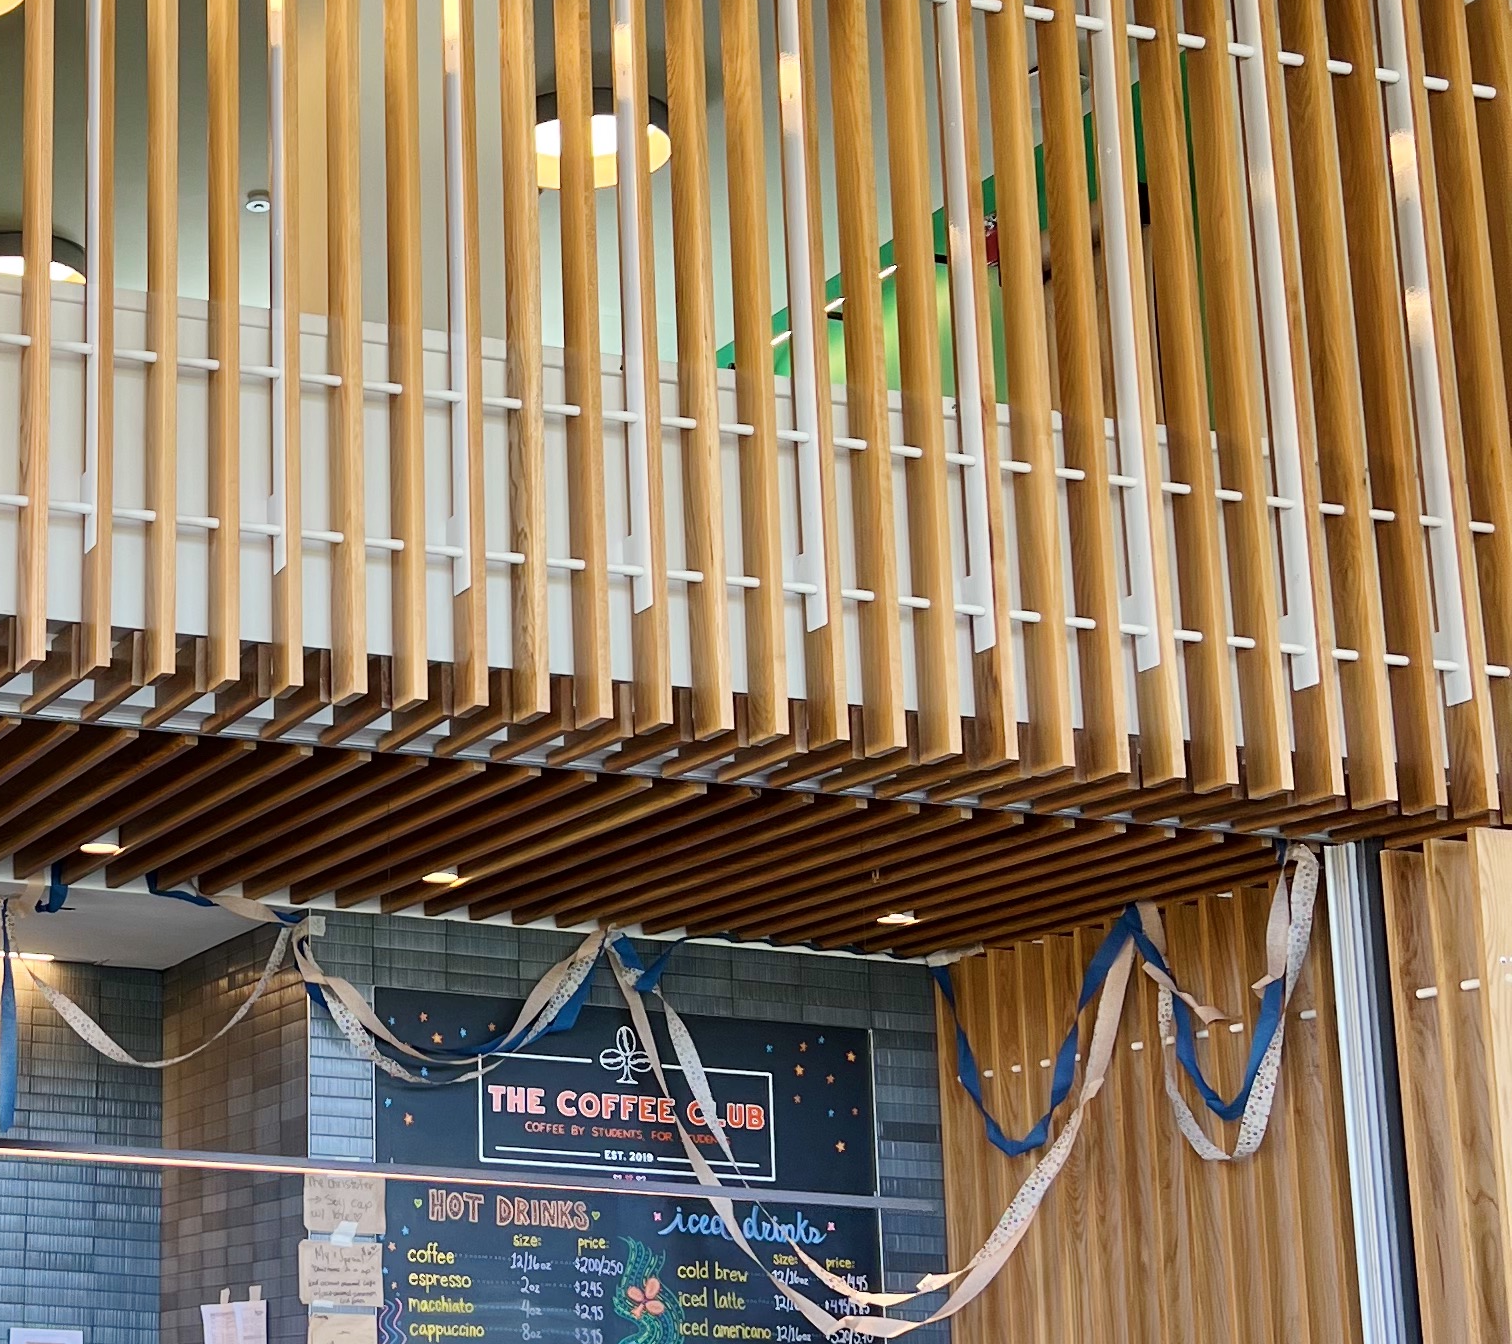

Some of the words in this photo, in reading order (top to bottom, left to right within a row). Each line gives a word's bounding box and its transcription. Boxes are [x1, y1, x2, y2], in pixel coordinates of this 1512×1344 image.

[487, 1085, 546, 1114] THE
[556, 1090, 676, 1123] COFFEE
[687, 1100, 765, 1130] CUB
[525, 1120, 565, 1135] COFFEE
[571, 1125, 585, 1136] BY
[651, 1131, 673, 1142] FOR
[604, 1150, 627, 1161] EST.
[629, 1151, 654, 1163] 2019
[428, 1188, 484, 1223] HOT
[496, 1194, 589, 1231] DRINKS
[743, 1204, 827, 1245] drinks
[407, 1242, 455, 1265] coffee
[512, 1234, 542, 1247] size:
[577, 1237, 610, 1256] price:
[677, 1261, 709, 1279] cold
[715, 1261, 749, 1282] brew
[773, 1254, 799, 1266] size:
[825, 1257, 856, 1271] price:
[408, 1273, 472, 1293] espresso
[408, 1296, 475, 1314] macchiato
[678, 1287, 708, 1308] iced
[714, 1288, 746, 1311] latte
[409, 1323, 485, 1343] cappuccino
[679, 1318, 708, 1338] iced
[713, 1321, 771, 1340] americano
